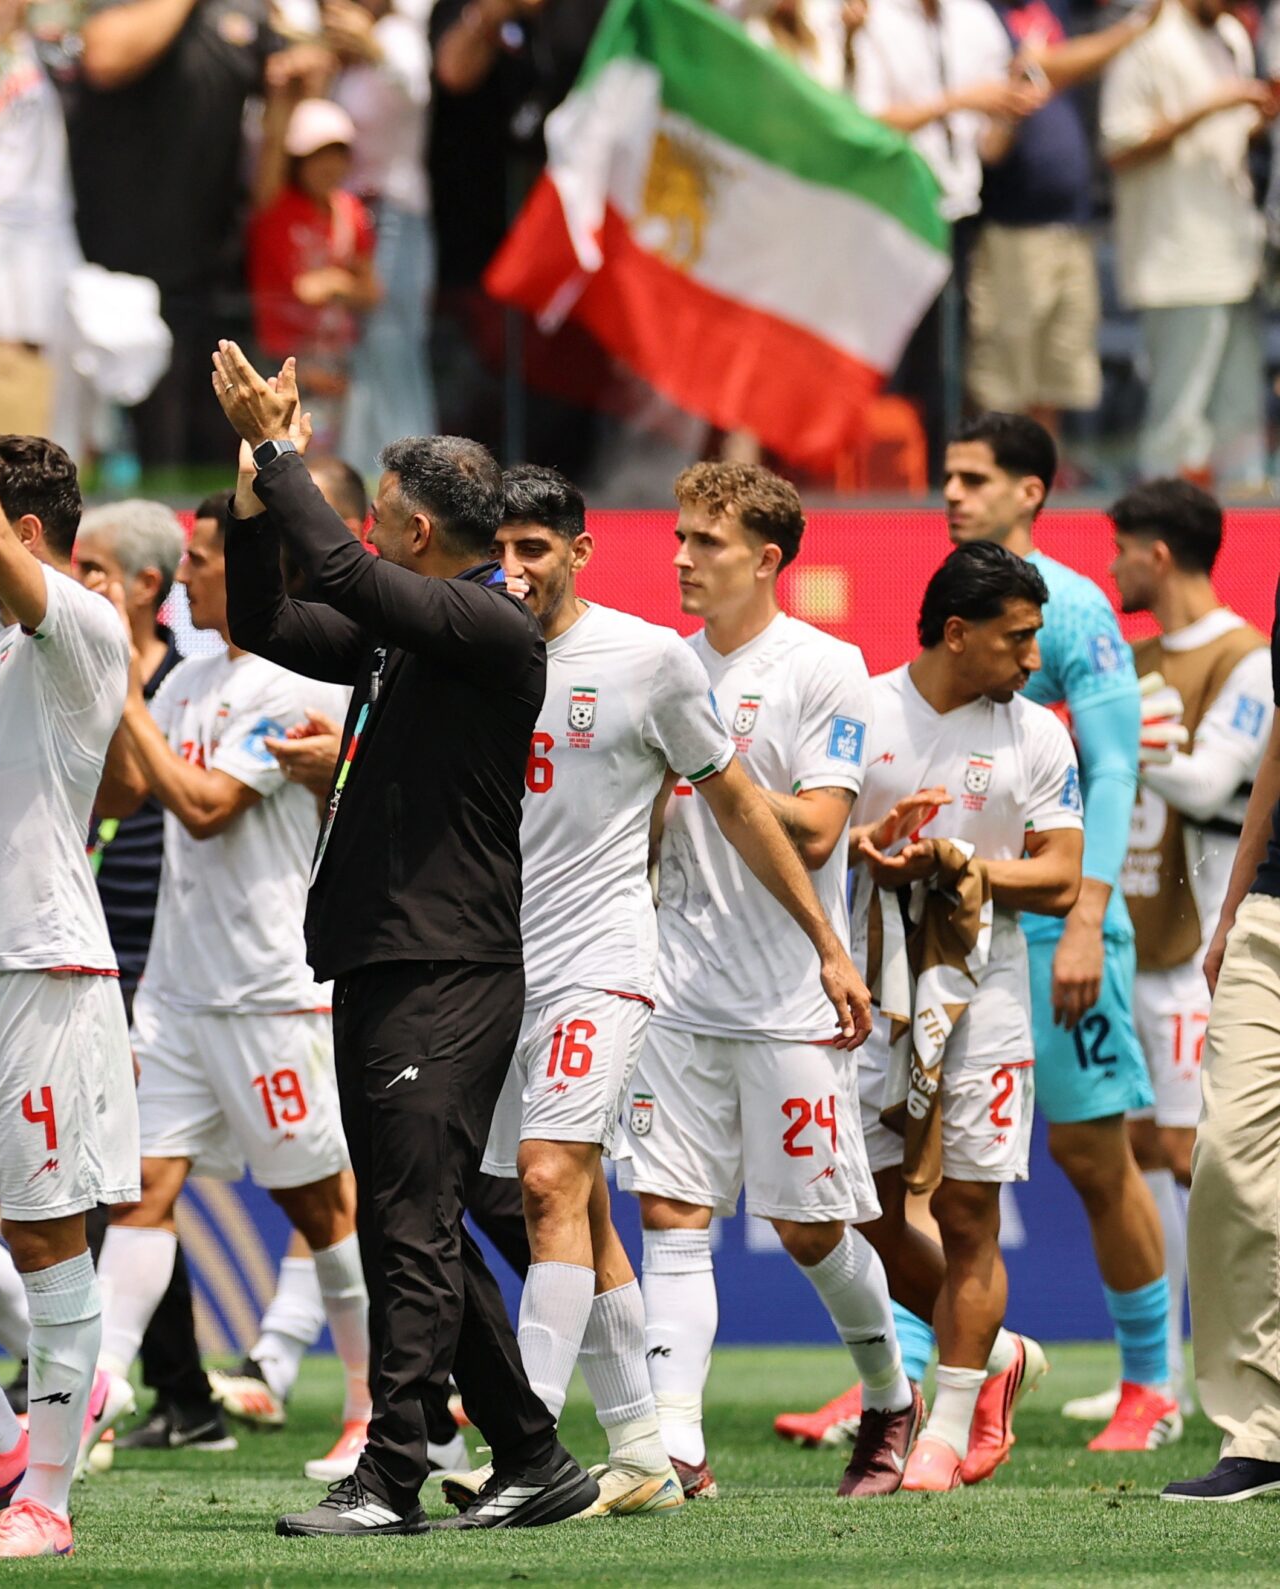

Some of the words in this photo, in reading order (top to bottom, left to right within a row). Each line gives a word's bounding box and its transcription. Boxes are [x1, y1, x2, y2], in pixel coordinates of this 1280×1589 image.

[526, 732, 554, 793] 6
[547, 1019, 597, 1078] 16
[917, 1007, 946, 1049] FIF
[1073, 1013, 1117, 1071] 12
[21, 1086, 58, 1151] 4
[252, 1068, 309, 1129] 19
[781, 1095, 838, 1157] 24
[989, 1070, 1014, 1128] 2
